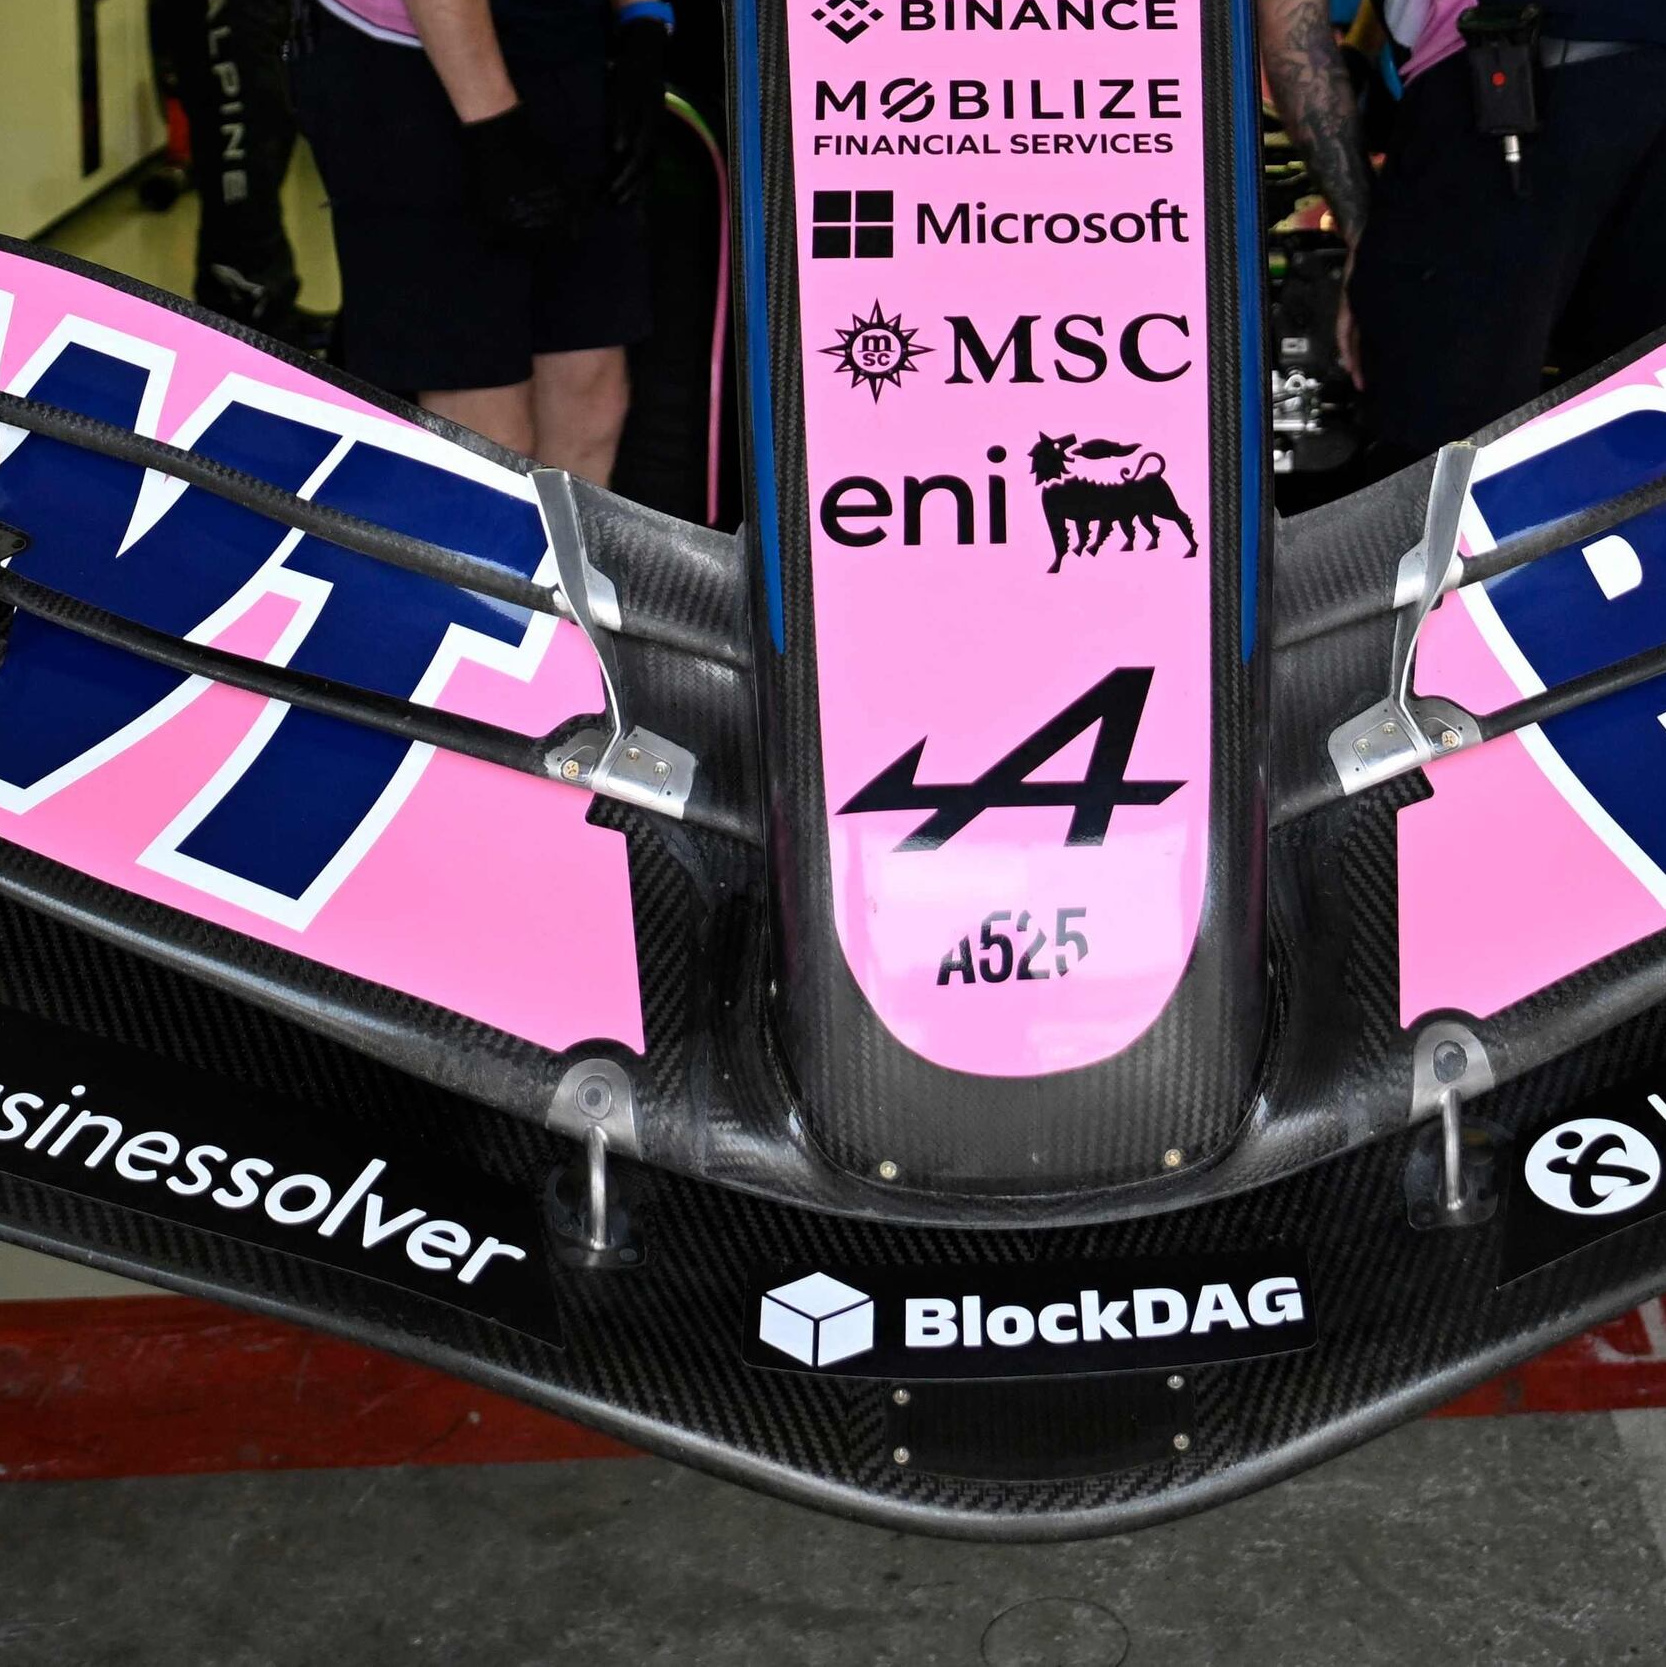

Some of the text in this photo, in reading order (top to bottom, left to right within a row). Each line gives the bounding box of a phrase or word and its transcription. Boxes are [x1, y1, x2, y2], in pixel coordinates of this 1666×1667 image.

[813, 133, 1173, 155] FINANCIAL SERVICES
[916, 198, 1189, 245] Microsoft
[943, 313, 1193, 385] MSC
[820, 445, 1007, 546] eni
[936, 906, 1089, 986] A525
[905, 1277, 1305, 1349] BlockDAG
